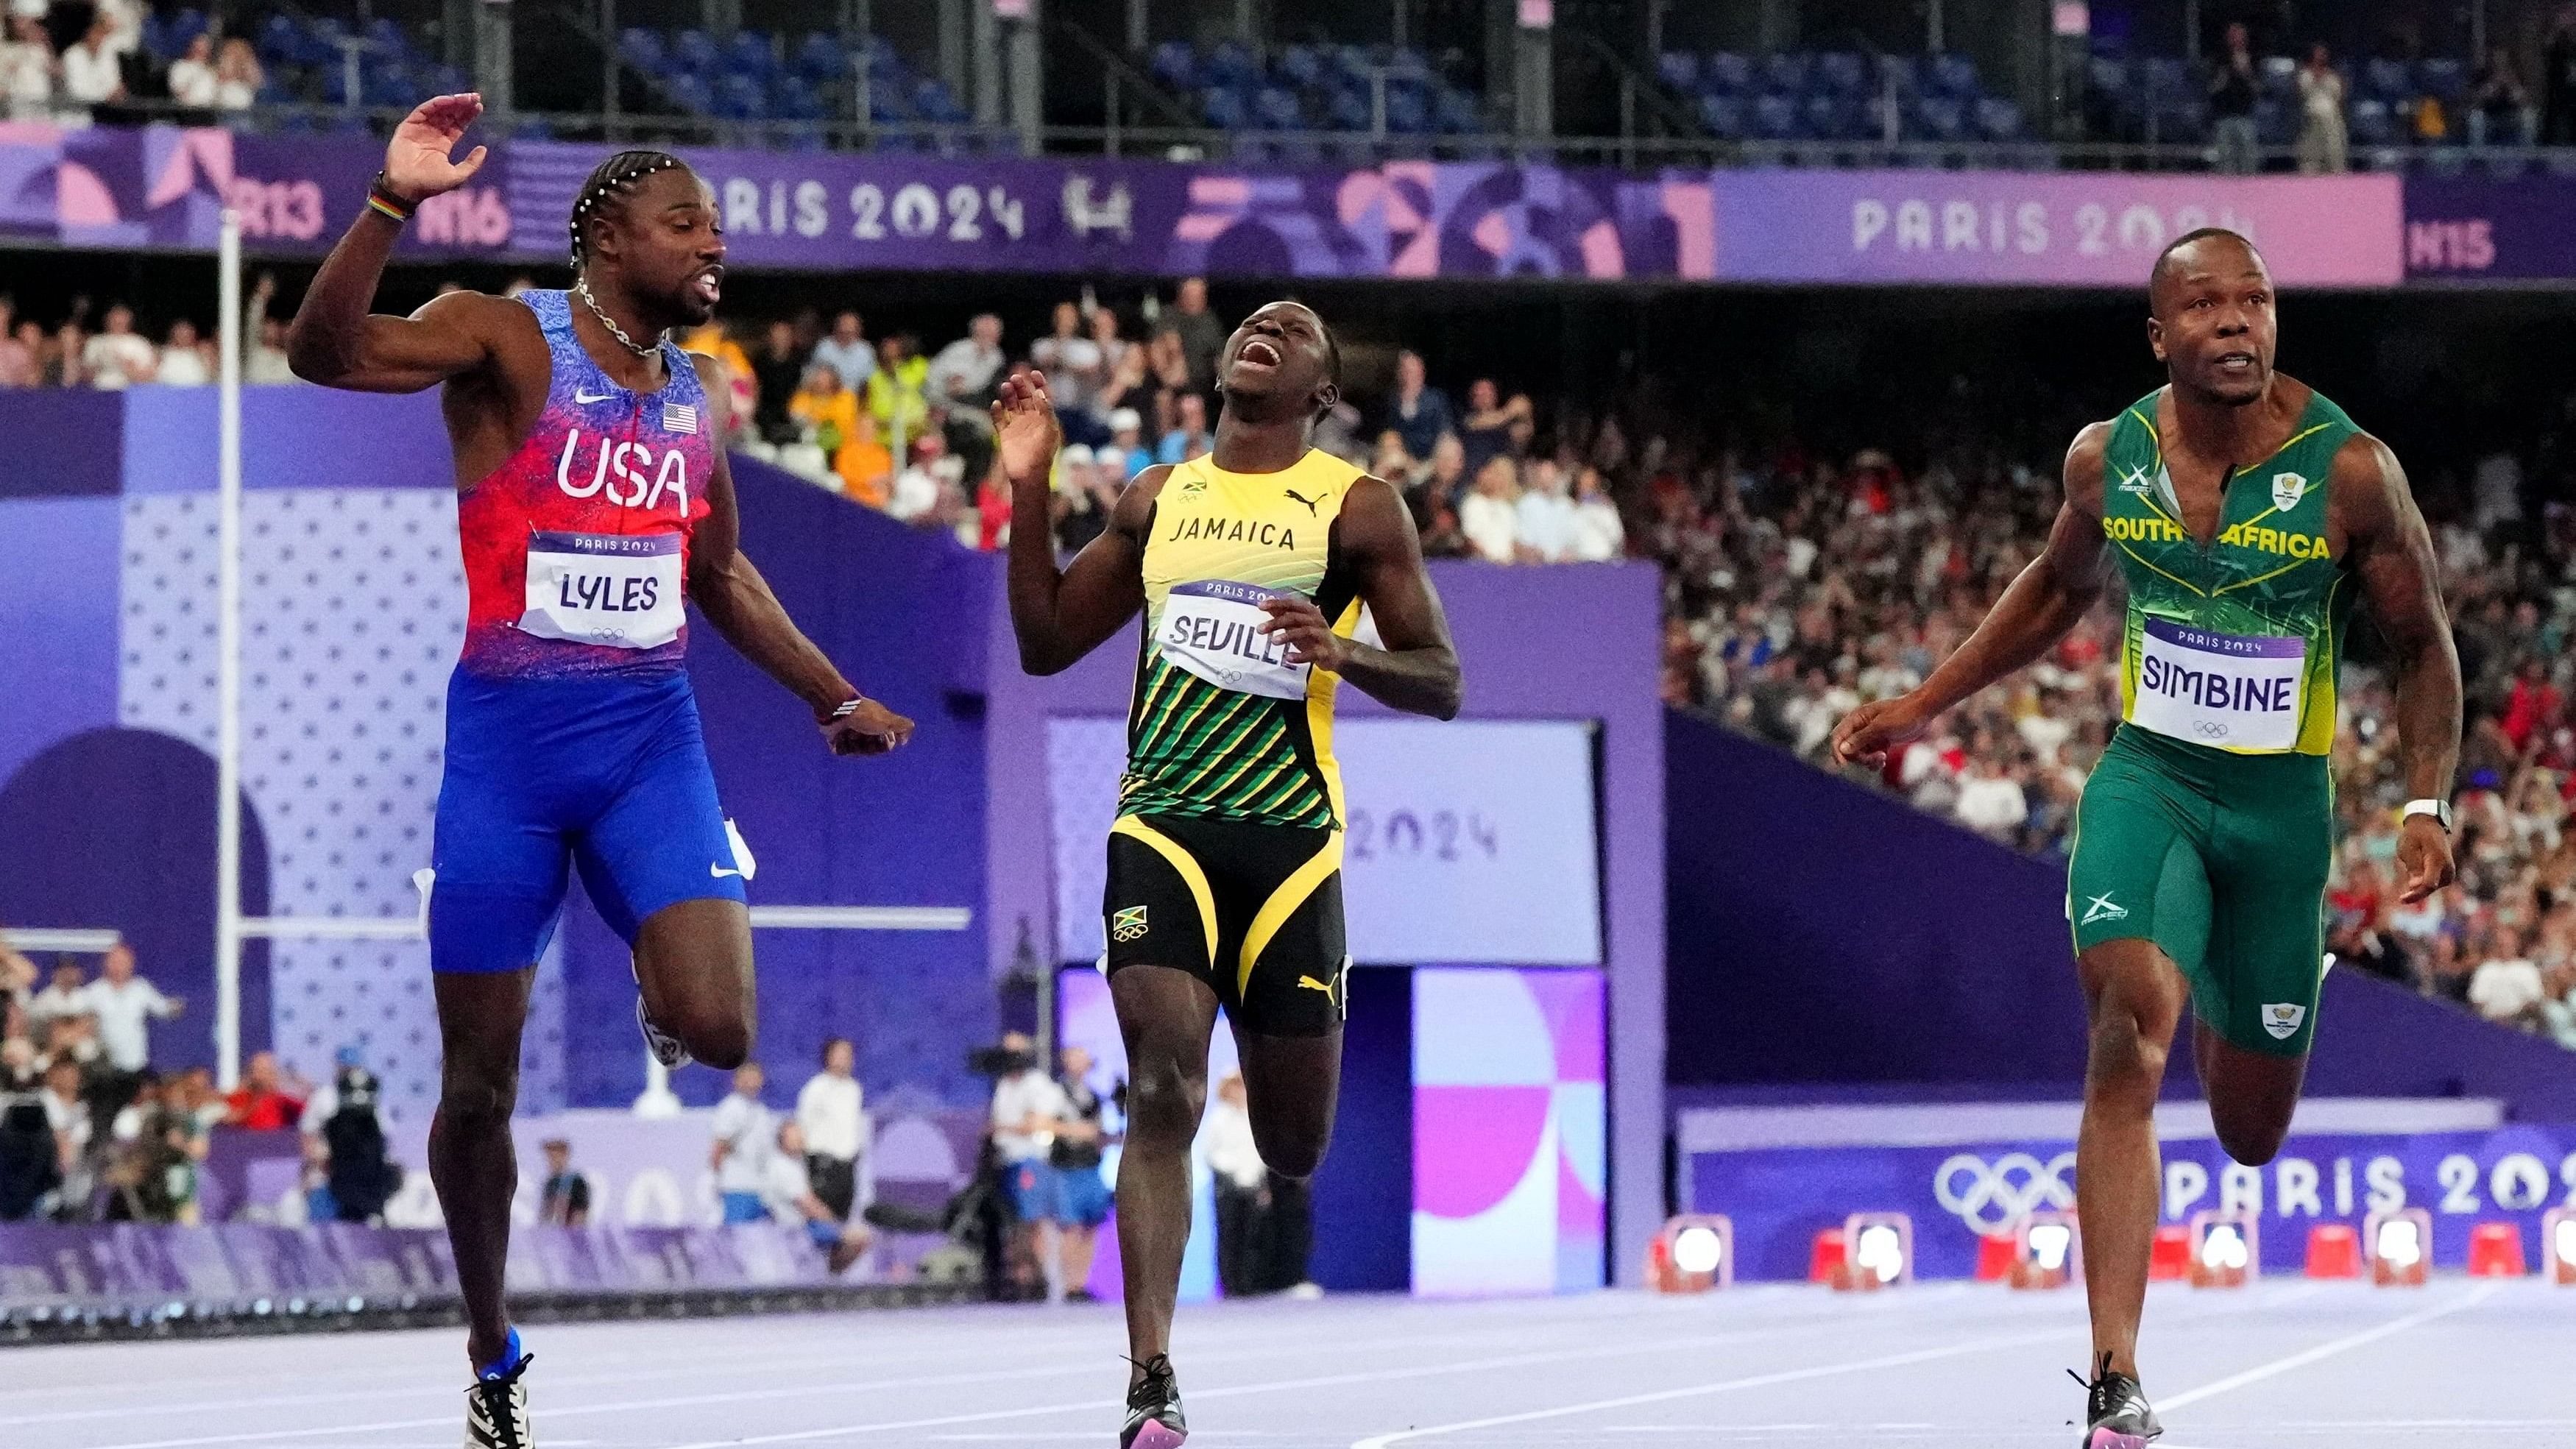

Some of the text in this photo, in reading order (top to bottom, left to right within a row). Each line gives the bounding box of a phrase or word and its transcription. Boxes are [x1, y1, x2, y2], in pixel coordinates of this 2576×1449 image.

[704, 177, 1025, 241] RIS 2024
[1853, 199, 2049, 255] PARIS
[557, 428, 688, 518] USA
[575, 538, 656, 552] PARIS 2024
[1170, 517, 1294, 551] JAMAICA
[2102, 517, 2330, 559] SOUTH AFRICA
[560, 574, 659, 612] LYLES
[1206, 583, 1244, 598] PARIS
[2179, 631, 2262, 652] PARIS 2024
[2142, 655, 2294, 712] SIMBINE
[1348, 809, 1498, 861] 2024
[2165, 1155, 2407, 1220] PARIS
